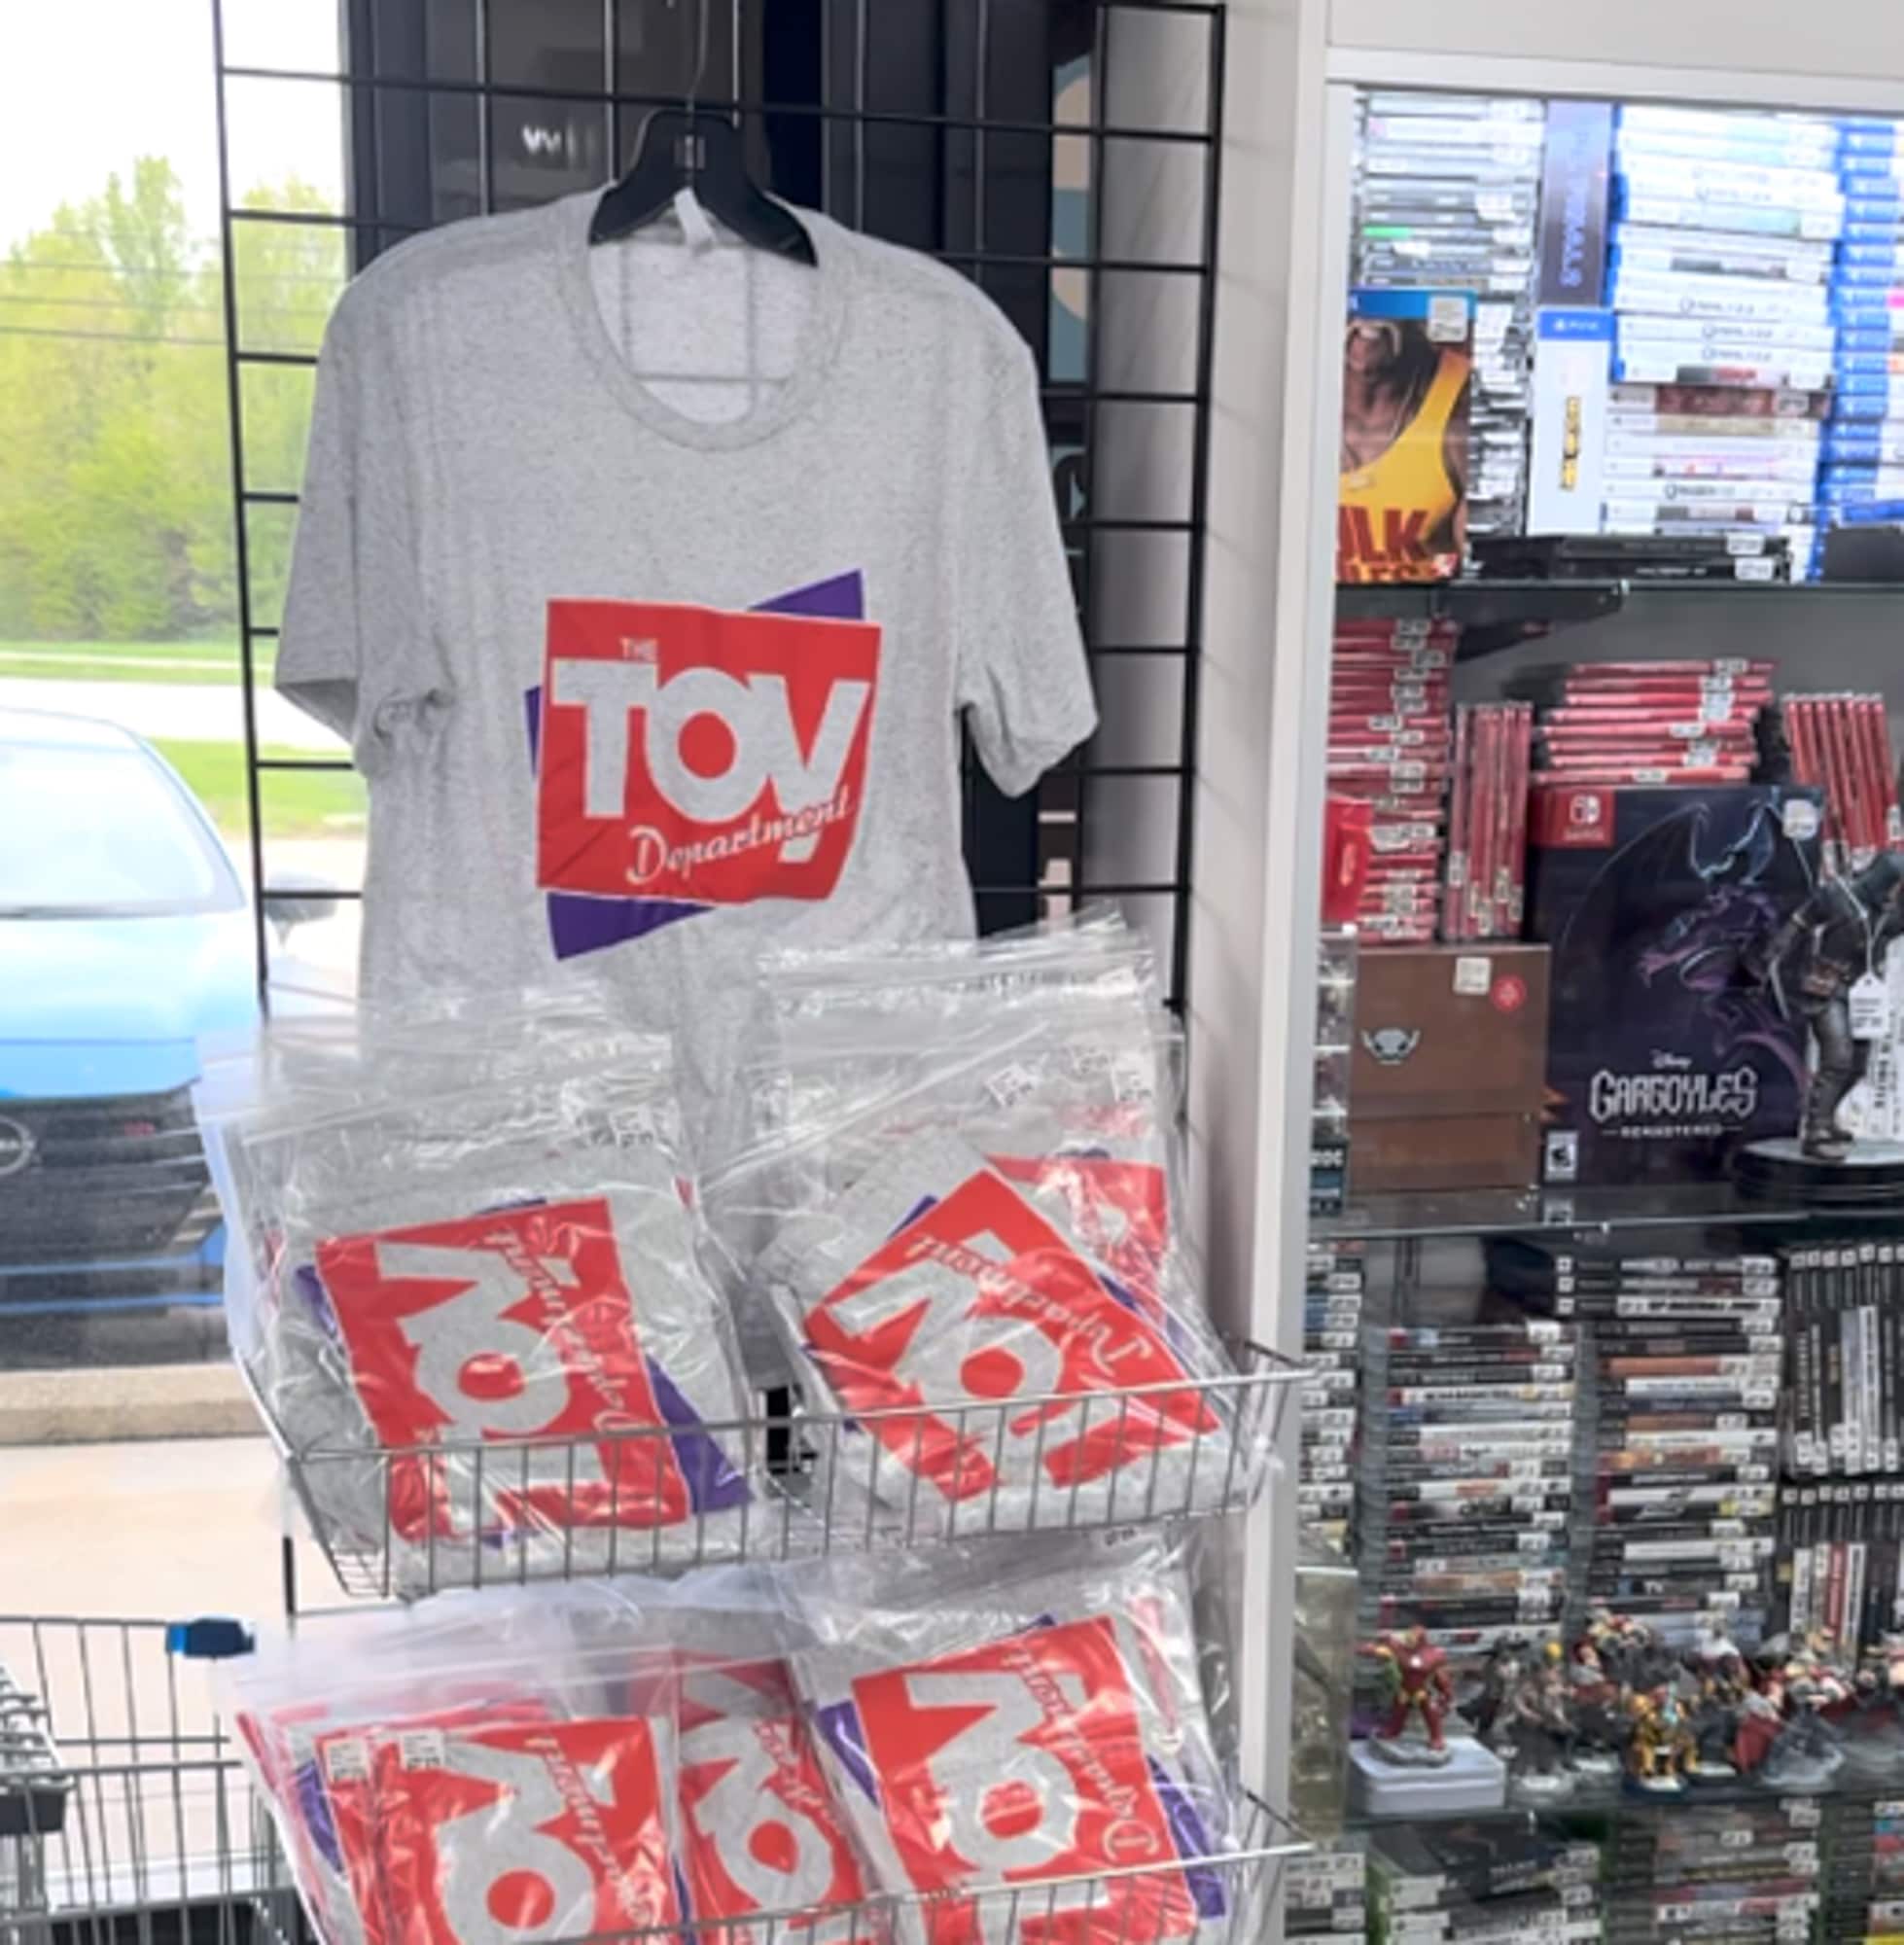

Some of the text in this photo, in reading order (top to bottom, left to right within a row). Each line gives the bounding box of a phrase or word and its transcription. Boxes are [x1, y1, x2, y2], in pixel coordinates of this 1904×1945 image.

[620, 638, 658, 662] THE
[550, 657, 871, 864] TOY
[625, 785, 852, 886] Department
[1589, 1066, 1758, 1124] GARGOYLES
